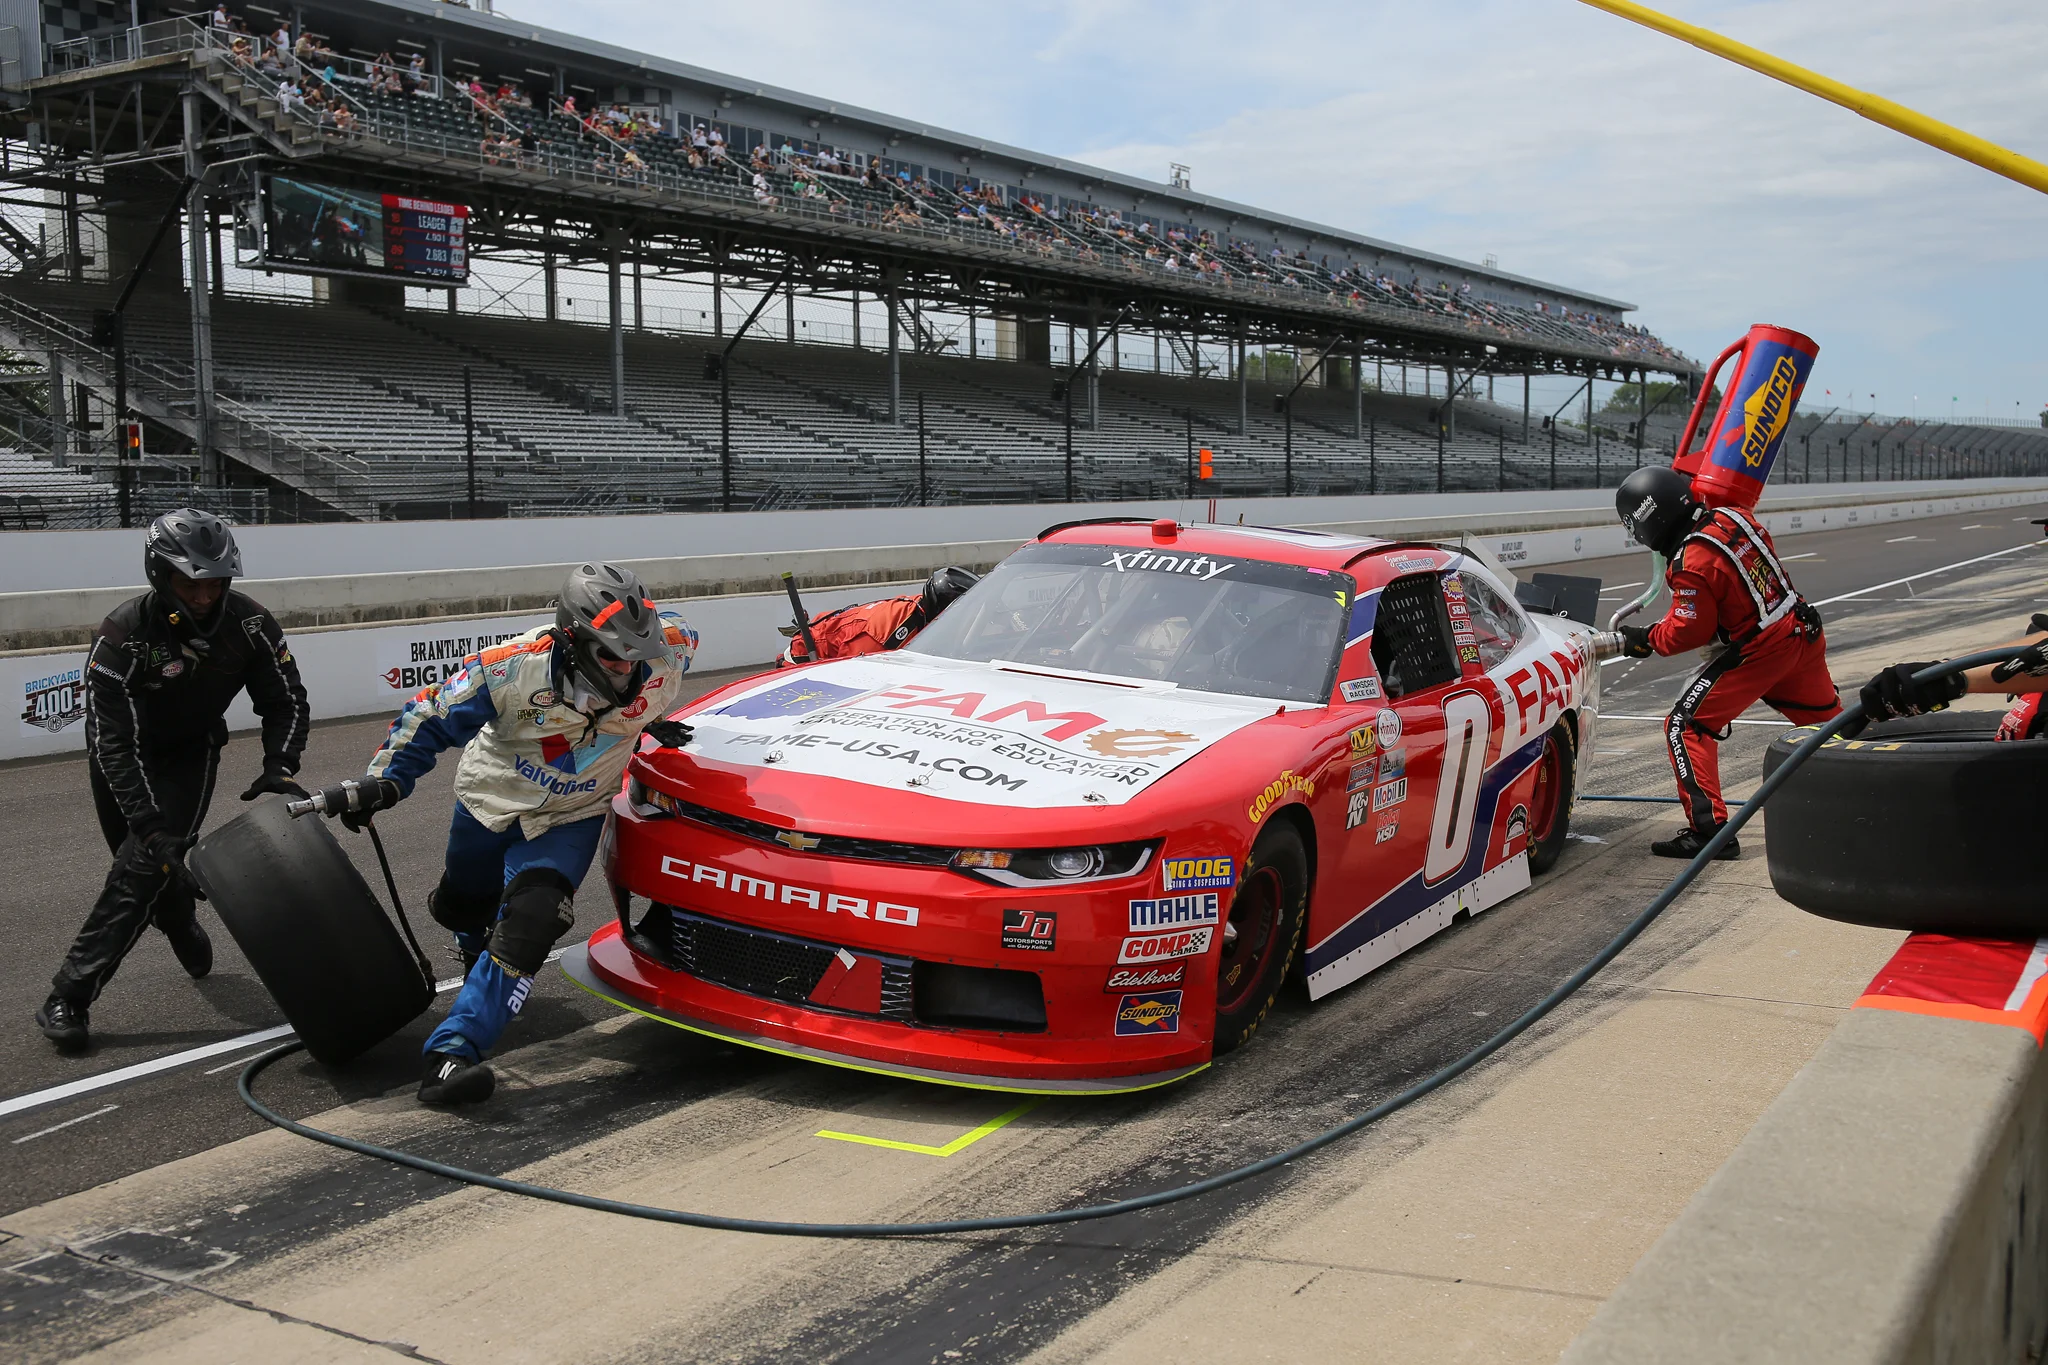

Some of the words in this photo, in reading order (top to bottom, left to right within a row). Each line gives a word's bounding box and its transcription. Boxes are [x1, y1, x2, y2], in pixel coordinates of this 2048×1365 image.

[418, 215, 446, 231] LEADER
[1744, 359, 1795, 464] SUNOCO
[1100, 550, 1236, 581] xfinity
[410, 637, 472, 662] BRANTLEY
[25, 669, 81, 693] BRICKYARD
[401, 665, 437, 688] BIG
[1351, 679, 1374, 690] NASCAR
[35, 686, 73, 719] 400
[1349, 689, 1366, 698] RACE
[1366, 688, 1377, 696] CAR
[724, 733, 1028, 792] FAME-USA.COM
[953, 727, 1004, 741] FOR
[1010, 742, 1150, 777] ADVANCED
[514, 753, 597, 796] Valvoline
[991, 744, 1141, 786] EDUCATION
[1248, 774, 1315, 824] GOODYEAR
[1374, 782, 1397, 807] Mobil
[1424, 692, 1491, 884] 0
[1375, 825, 1396, 845] MSD
[660, 855, 920, 927] CAMARO
[1193, 877, 1231, 887] SUSPENSION
[1131, 894, 1217, 926] MAHLE
[1004, 910, 1055, 939] JD
[1003, 937, 1053, 946] MOTORSPORTS
[1125, 933, 1192, 958] COMP
[1169, 945, 1200, 957] CAMS
[1108, 966, 1184, 987] Edelbrock
[1121, 1005, 1176, 1019] SUNOCO
